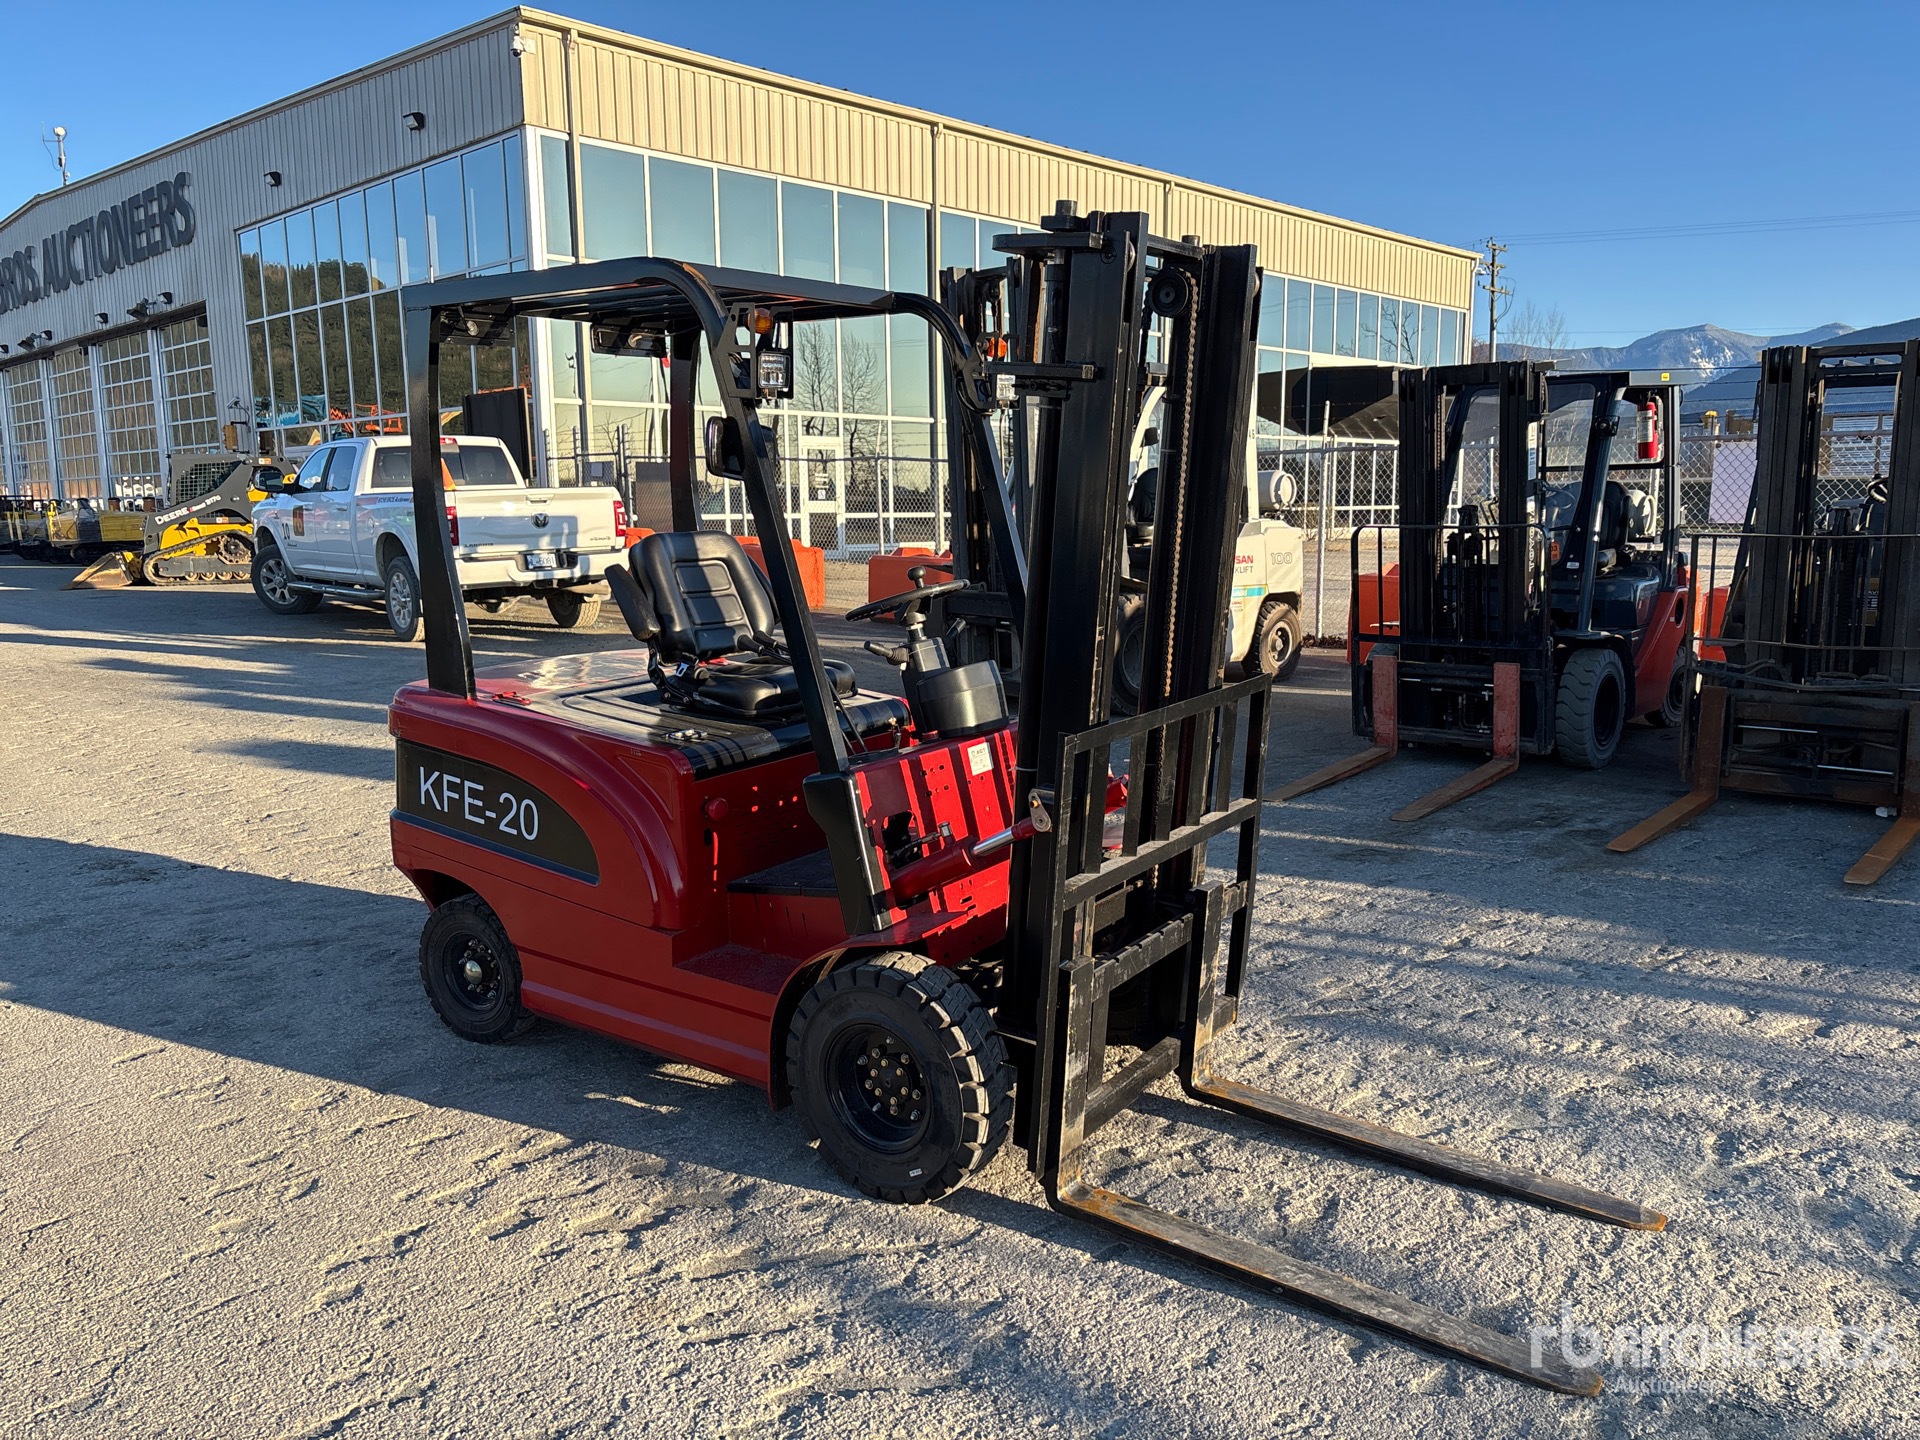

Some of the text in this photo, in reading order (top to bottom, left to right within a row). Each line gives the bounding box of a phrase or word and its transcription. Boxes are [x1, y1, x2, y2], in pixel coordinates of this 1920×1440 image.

[42, 171, 196, 297] AUCTIONEERS
[155, 507, 190, 525] DEERE
[1234, 554, 1254, 564] SAN
[1270, 552, 1292, 565] 100
[1234, 565, 1254, 574] KLIFT
[419, 766, 539, 841] KFE-20
